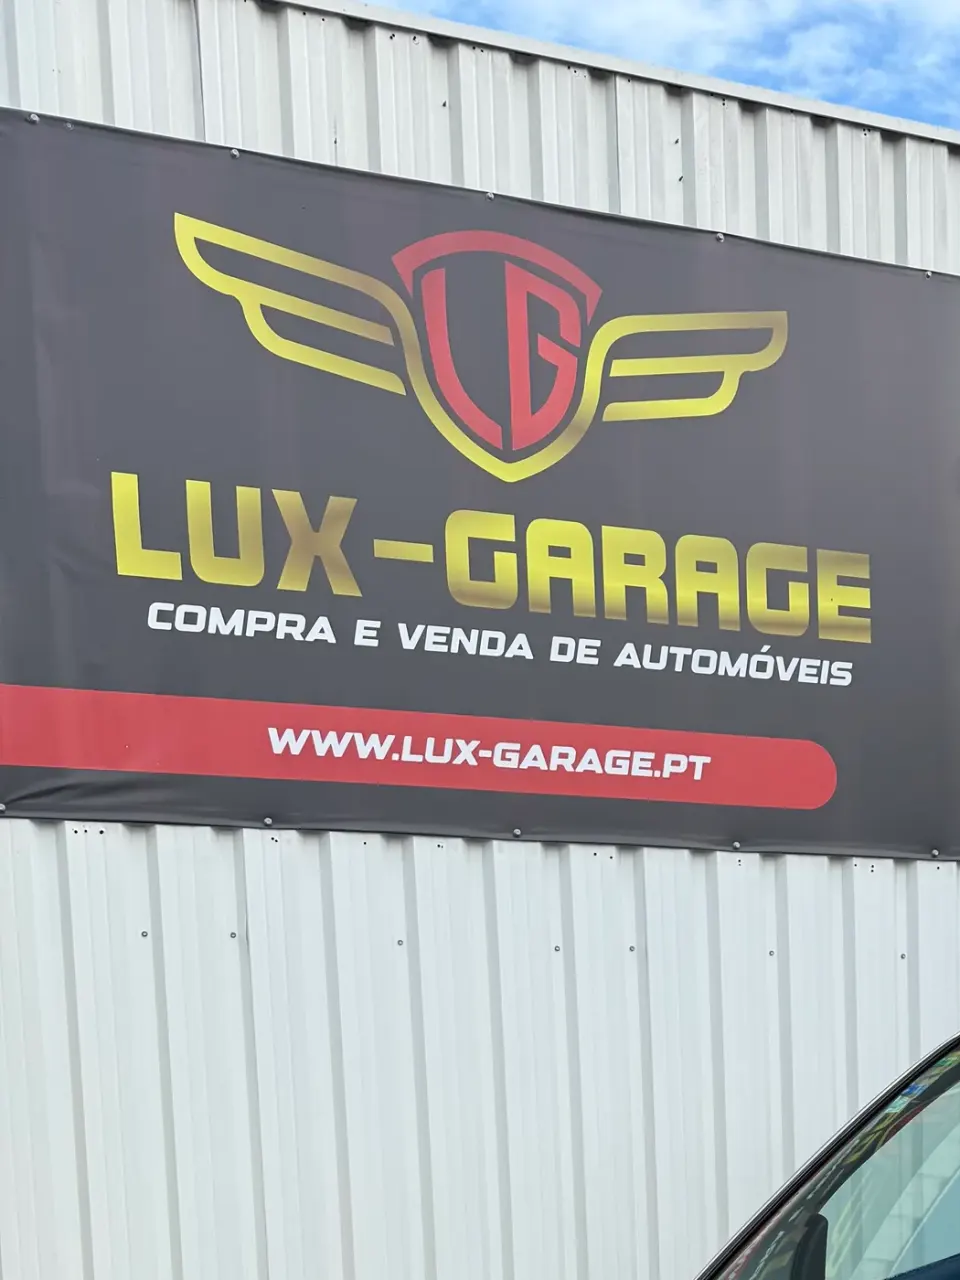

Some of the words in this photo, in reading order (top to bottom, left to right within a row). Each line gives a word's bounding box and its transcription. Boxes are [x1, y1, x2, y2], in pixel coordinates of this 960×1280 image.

[110, 471, 872, 644] LUX-GARAGE
[147, 601, 337, 644] COMPRA
[353, 619, 382, 647] E
[397, 622, 534, 660] VENDA
[549, 635, 602, 665] DE
[613, 644, 853, 687] AUTOMÓVEIS
[267, 727, 712, 781] WWW.LUX-GARAGE.PT
